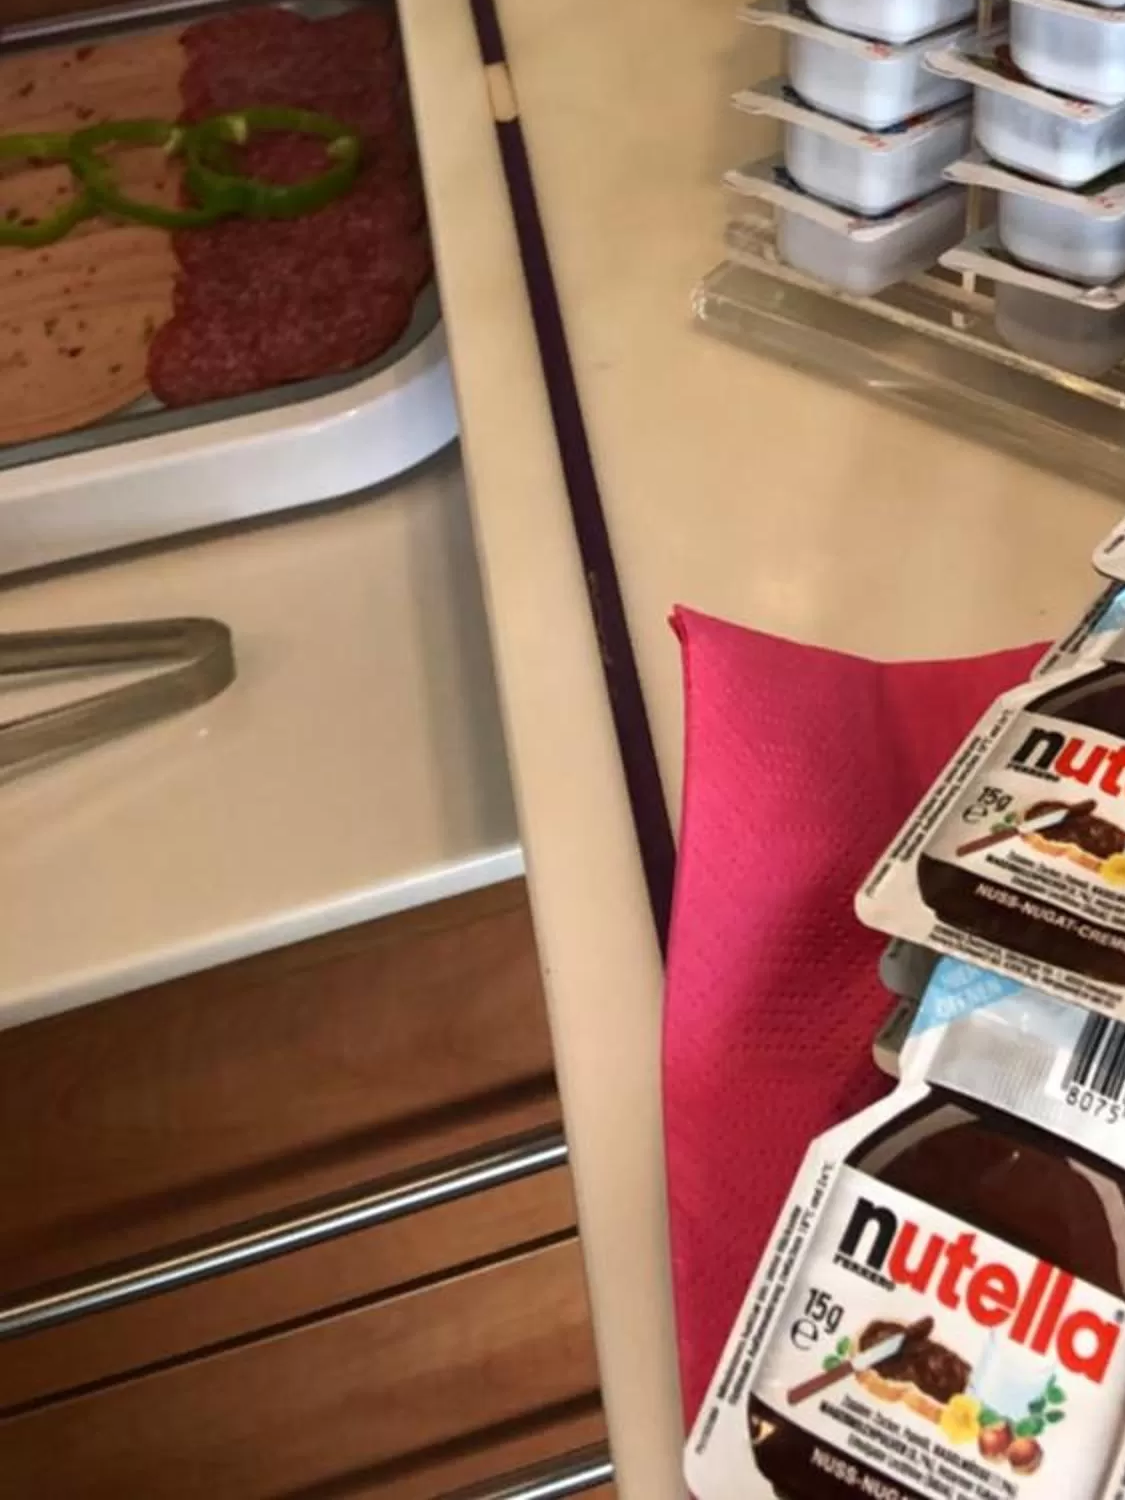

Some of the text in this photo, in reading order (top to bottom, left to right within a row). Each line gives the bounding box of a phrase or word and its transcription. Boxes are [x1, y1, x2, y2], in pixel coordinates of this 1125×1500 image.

[975, 784, 1014, 810] 15g
[1063, 1084, 1121, 1125] 8075
[802, 1287, 844, 1335] 15g
[838, 1194, 1123, 1385] nutella
[810, 1446, 908, 1500] NUSS-NUG
